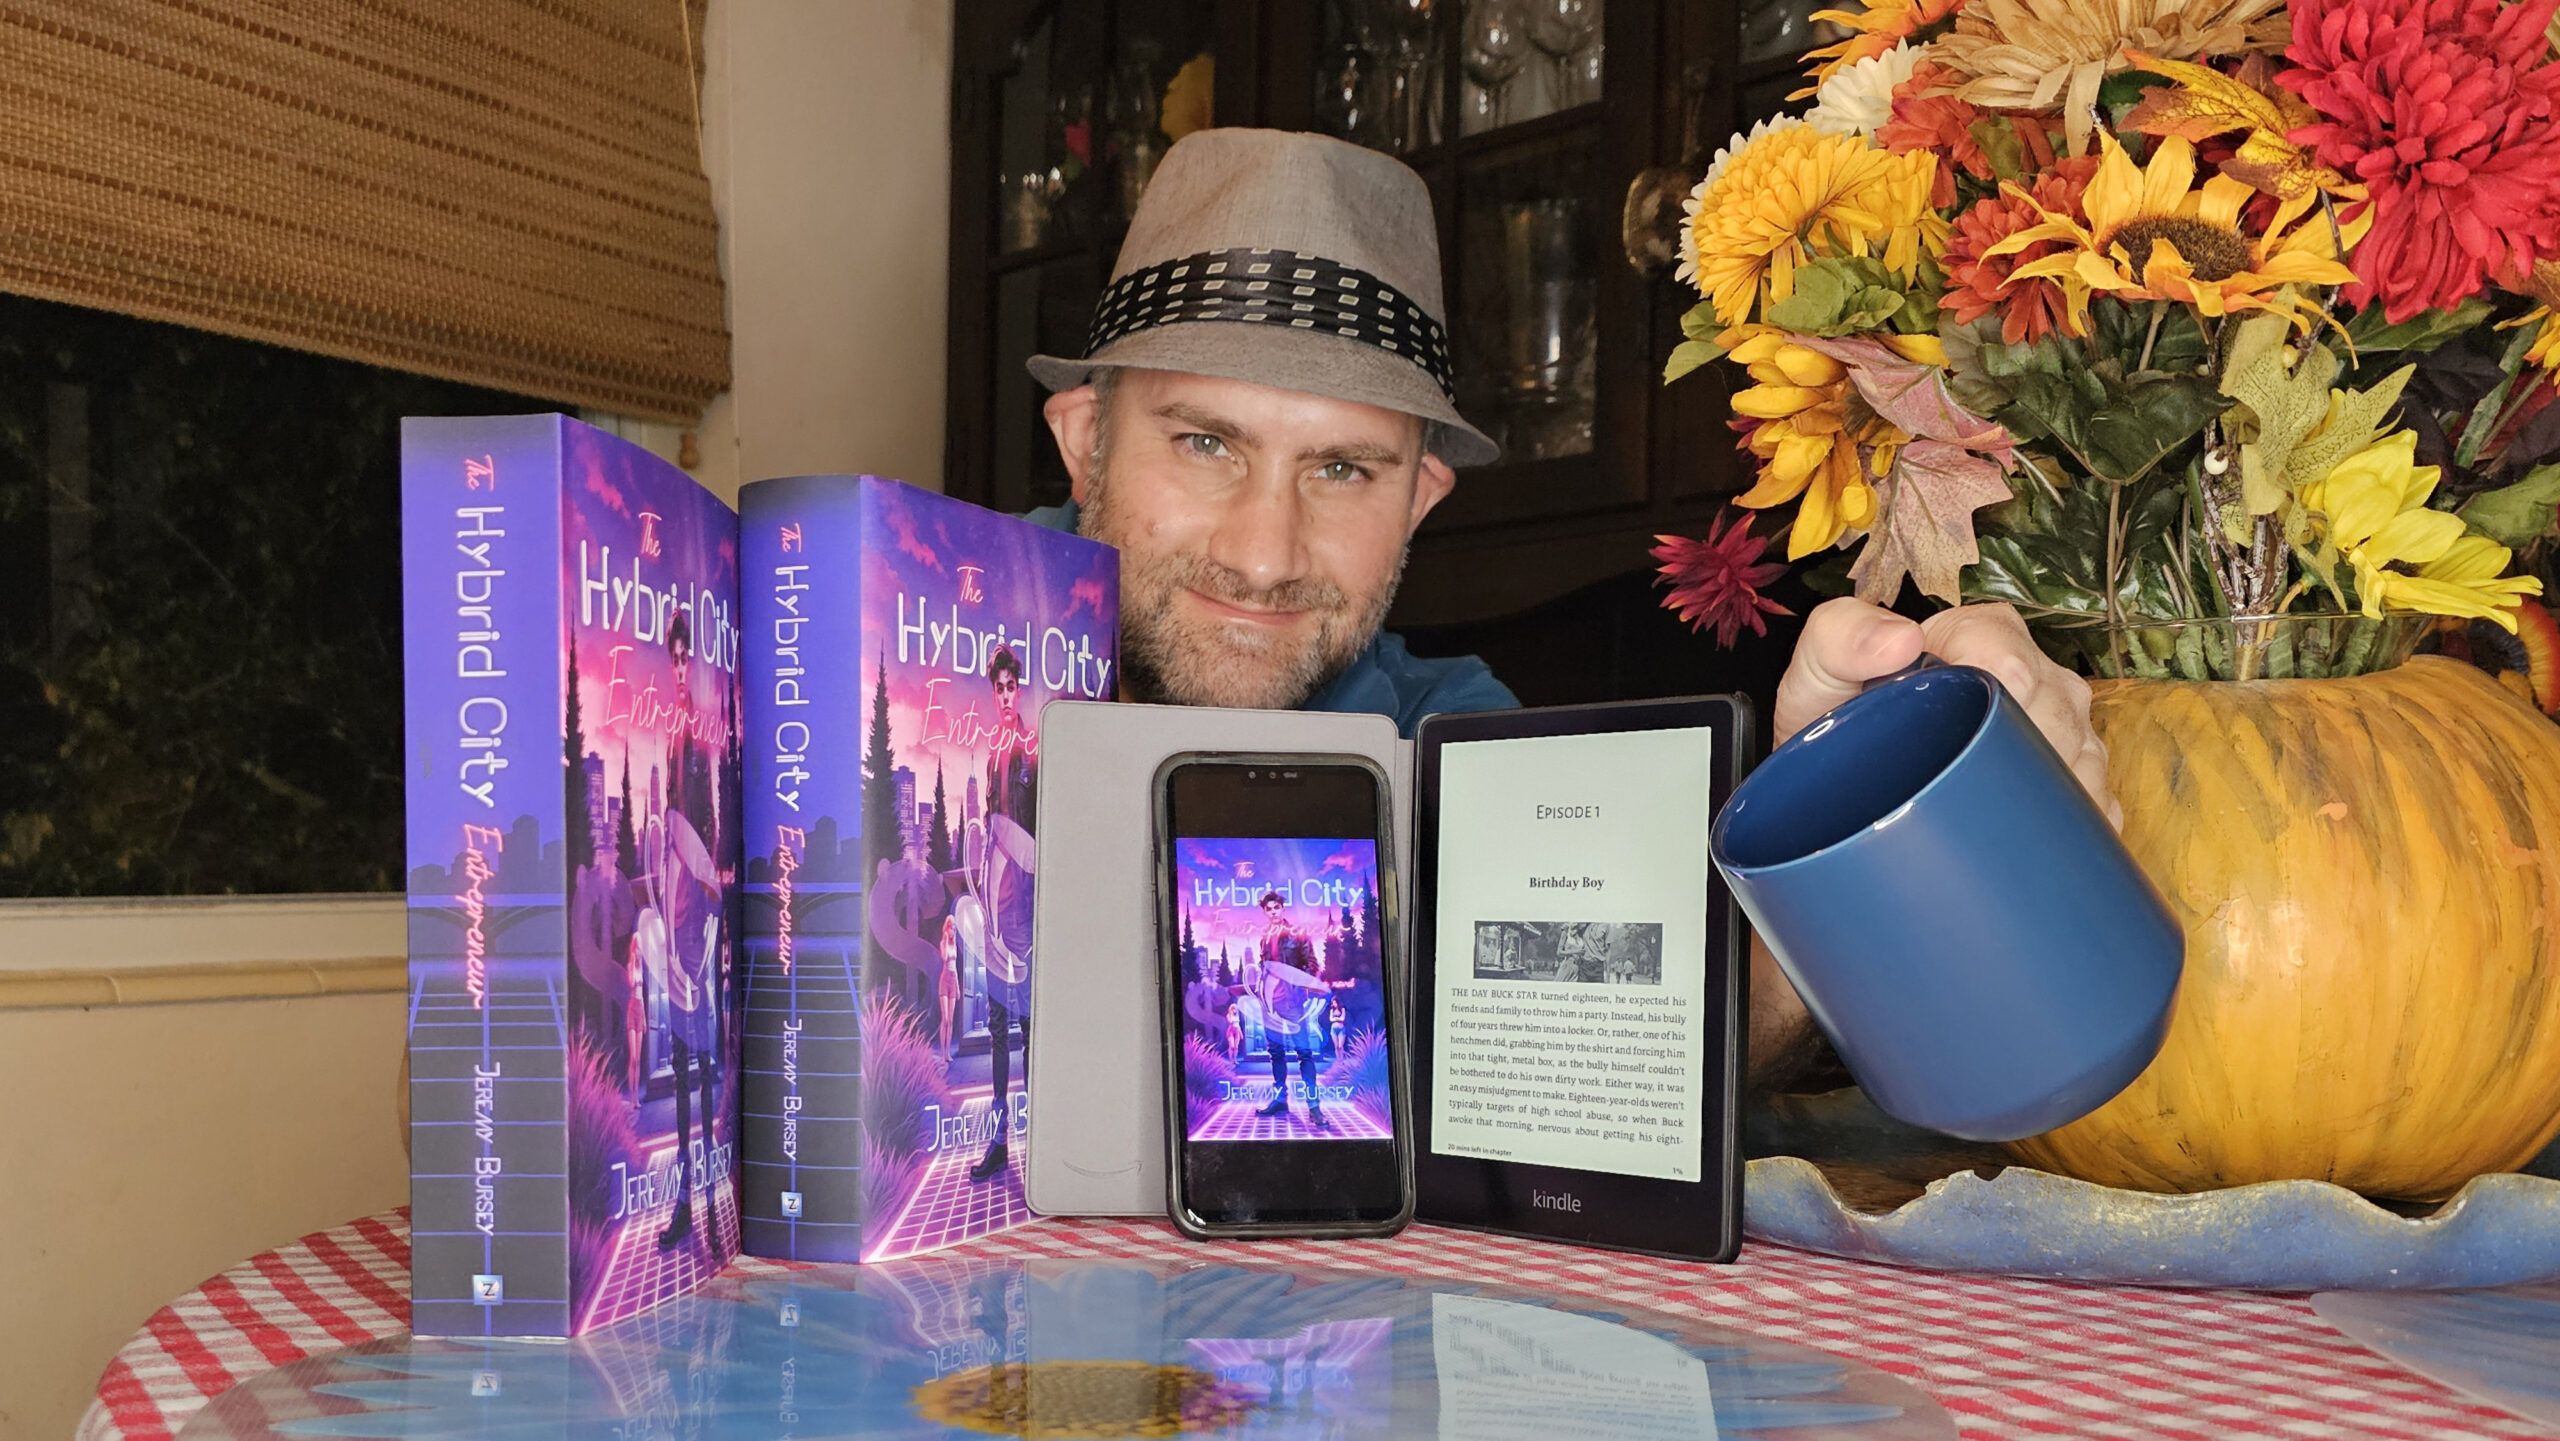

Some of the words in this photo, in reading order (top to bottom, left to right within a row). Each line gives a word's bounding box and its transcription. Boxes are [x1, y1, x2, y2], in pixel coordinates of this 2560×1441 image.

[463, 454, 494, 491] The
[638, 511, 662, 557] The
[780, 523, 801, 553] The
[456, 507, 507, 678] Hybrid
[956, 566, 984, 603] The
[700, 589, 739, 674] City
[775, 565, 810, 706] Hybrid
[1042, 627, 1111, 698] City
[606, 645, 733, 760] Entrepreneur
[921, 678, 1039, 773] Entrepre
[459, 697, 508, 808] City
[775, 721, 810, 812] City
[1594, 805, 1601, 819] 1
[1233, 861, 1255, 879] The
[1529, 876, 1580, 891] Birthday
[1582, 877, 1605, 891] Boy
[772, 824, 806, 976] Entrepreneur
[1301, 878, 1364, 907] City
[456, 823, 503, 1011] Entrepreneur
[1450, 988, 1468, 997] THE
[1471, 989, 1488, 998] DAY
[1490, 989, 1513, 999] BUCK
[1515, 990, 1538, 1000] STAR
[1540, 991, 1569, 1001] turned
[1614, 994, 1626, 1004] he
[1628, 995, 1669, 1008] expected
[1671, 996, 1687, 1006] his
[1450, 1004, 1478, 1013] friends
[1479, 1005, 1494, 1014] and
[1495, 1006, 1522, 1018] family
[1522, 1007, 1532, 1016] to
[1532, 1007, 1558, 1017] throw
[1559, 1008, 1577, 1018] him
[1647, 1012, 1661, 1022] his
[1662, 1013, 1686, 1026] bully
[1450, 1019, 1458, 1028] of
[1459, 1020, 1476, 1029] four
[1476, 1023, 1498, 1033] years
[1499, 1022, 1523, 1032] threw
[1524, 1023, 1541, 1033] him
[1542, 1024, 1560, 1034] into
[1642, 1031, 1659, 1039] one
[1660, 1030, 1671, 1040] of
[1671, 1031, 1685, 1041] his
[1449, 1051, 1466, 1060] into
[1467, 1052, 1484, 1061] that
[1510, 1055, 1535, 1065] metal
[1569, 1058, 1584, 1068] the
[1585, 1059, 1609, 1073] bully
[1610, 1061, 1646, 1073] himself
[1450, 1035, 1491, 1046] henchmen
[1509, 1038, 1545, 1052] grabbing
[1546, 1041, 1563, 1050] him
[1564, 1042, 1575, 1054] by
[1576, 1042, 1591, 1052] the
[1592, 1043, 1613, 1053] shirt
[1614, 1045, 1631, 1055] and
[1632, 1046, 1665, 1060] forcing
[1666, 1048, 1685, 1058] him
[1448, 1084, 1459, 1092] an
[1458, 1085, 1477, 1096] easy
[1477, 1084, 1531, 1100] misjudgment
[1531, 1089, 1541, 1098] to
[1449, 1066, 1459, 1076] be
[1459, 1067, 1495, 1078] bothered
[1496, 1070, 1506, 1079] to
[1507, 1070, 1518, 1080] do
[1519, 1071, 1532, 1081] his
[1533, 1074, 1553, 1083] own
[1554, 1074, 1576, 1087] dirty
[1604, 1077, 1632, 1089] Either
[1656, 1081, 1664, 1091] it
[1666, 1084, 1685, 1092] was
[1448, 1098, 1482, 1112] typically
[1486, 1101, 1514, 1115] targets
[1518, 1104, 1527, 1113] of
[1530, 1105, 1550, 1118] high
[1554, 1107, 1581, 1118] school
[1618, 1114, 1628, 1122] so
[1632, 1114, 1656, 1125] when
[1661, 1116, 1683, 1127] Buck
[1447, 1114, 1473, 1124] awoke
[1475, 1116, 1492, 1126] that
[1537, 1124, 1571, 1134] nervous
[1574, 1125, 1599, 1136] about
[1602, 1128, 1635, 1143] getting
[1638, 1131, 1653, 1141] his
[1655, 1133, 1683, 1147] eight-
[1532, 1188, 1582, 1213] kindle
